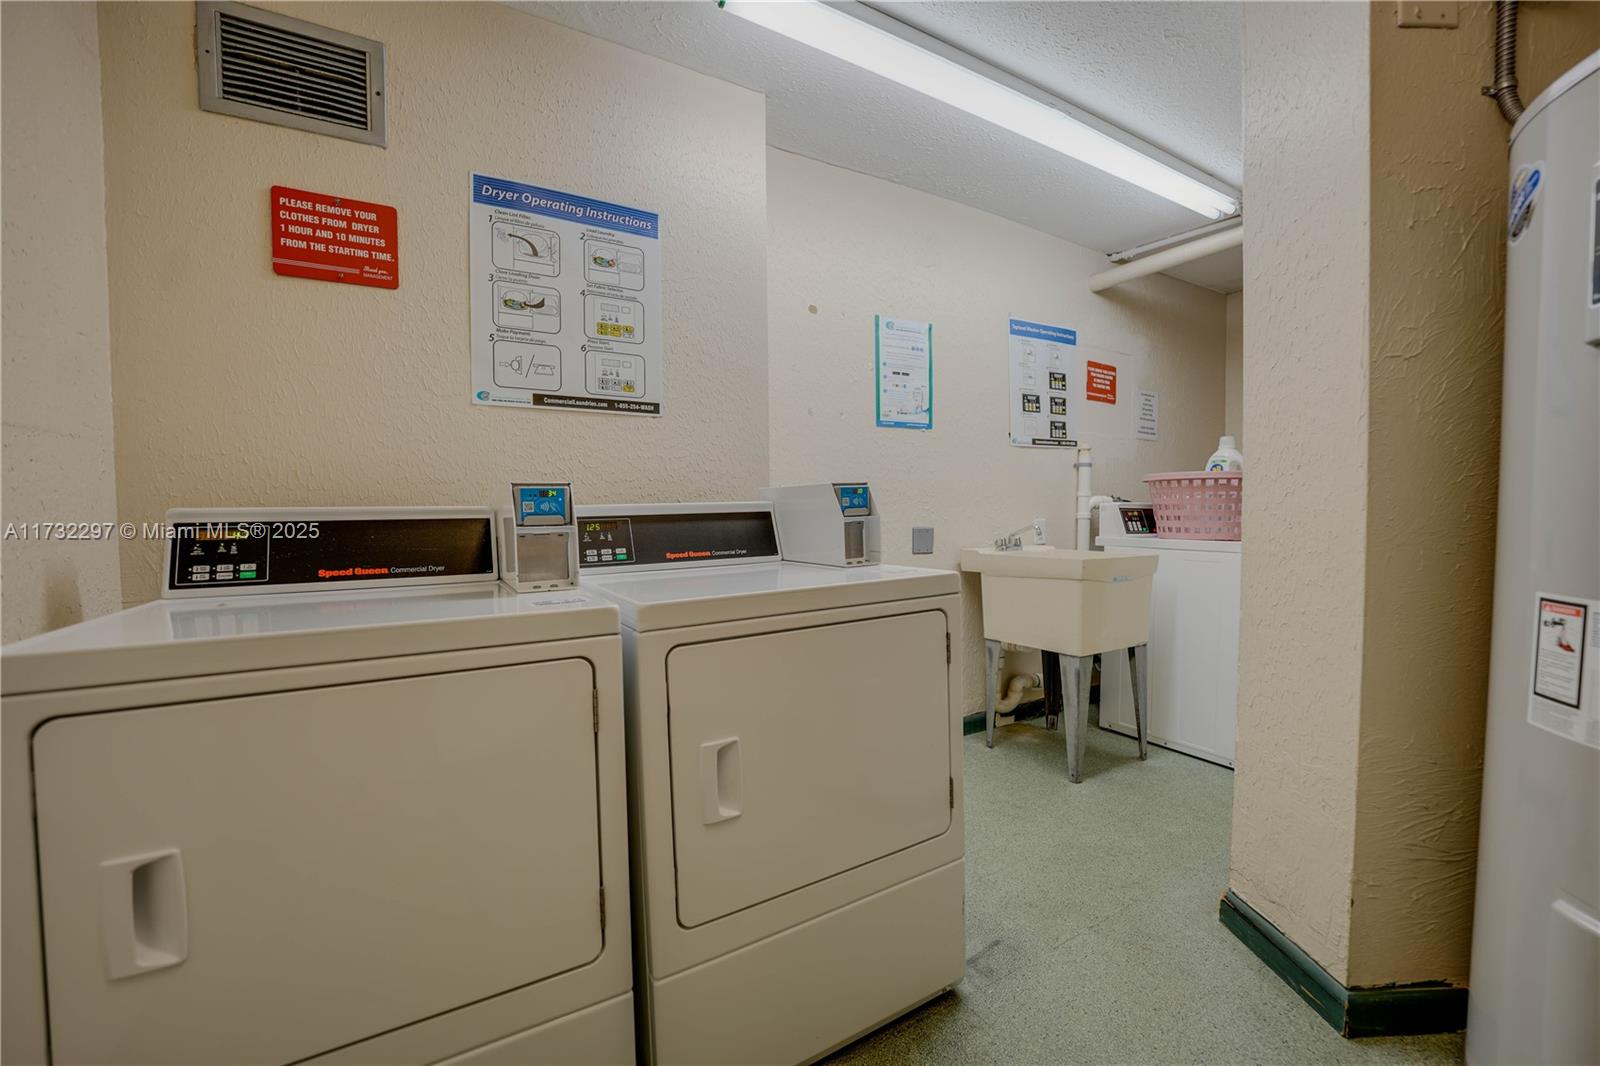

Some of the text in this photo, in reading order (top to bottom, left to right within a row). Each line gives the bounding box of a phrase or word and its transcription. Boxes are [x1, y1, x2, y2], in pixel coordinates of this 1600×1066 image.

[279, 197, 377, 221] PLEASE REMOVE YOUR
[481, 184, 652, 230] Dryer Operating Instructions
[279, 210, 380, 234] CLOTHES FROM DRYER
[489, 214, 493, 222] 1
[280, 224, 386, 247] 1 HOUR AND 10 MINUTES
[580, 231, 586, 240] 2
[280, 237, 395, 262] FROM THE STARTING TIME.
[488, 273, 494, 282] 3
[580, 289, 586, 297] 4
[489, 333, 495, 341] 5
[580, 344, 587, 352] 6
[586, 523, 601, 531] 125
[665, 551, 689, 560] Speed
[688, 550, 711, 558] Queen
[318, 565, 446, 578] Speed Queen Commercial Dryer
